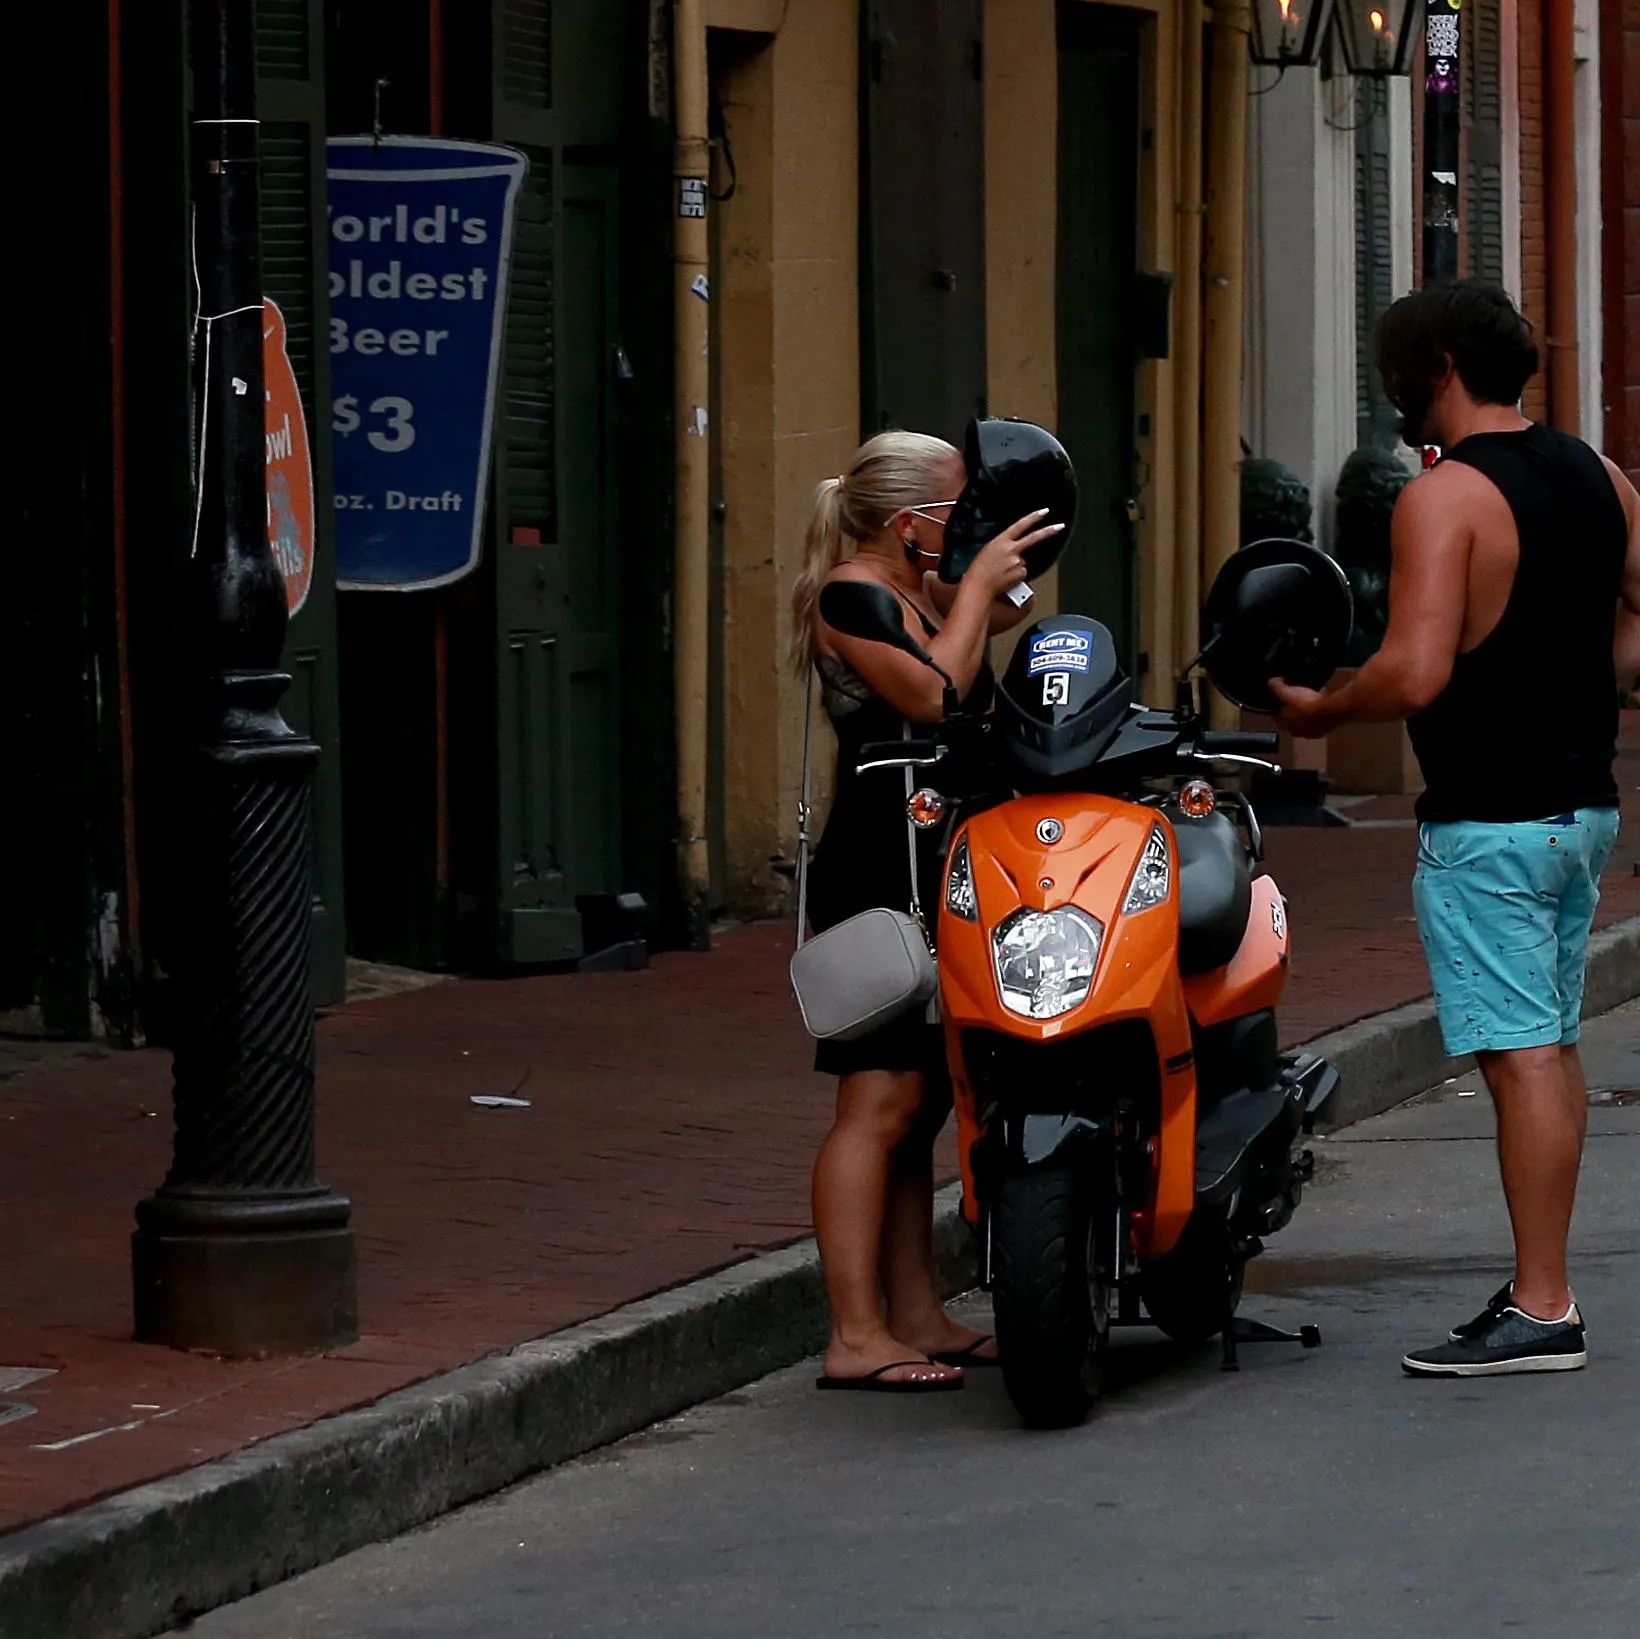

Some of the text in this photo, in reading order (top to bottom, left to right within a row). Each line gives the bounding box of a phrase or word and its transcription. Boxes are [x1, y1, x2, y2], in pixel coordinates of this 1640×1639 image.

[327, 204, 487, 245] orld's
[386, 490, 462, 512] Draft
[1046, 675, 1064, 701] 5
